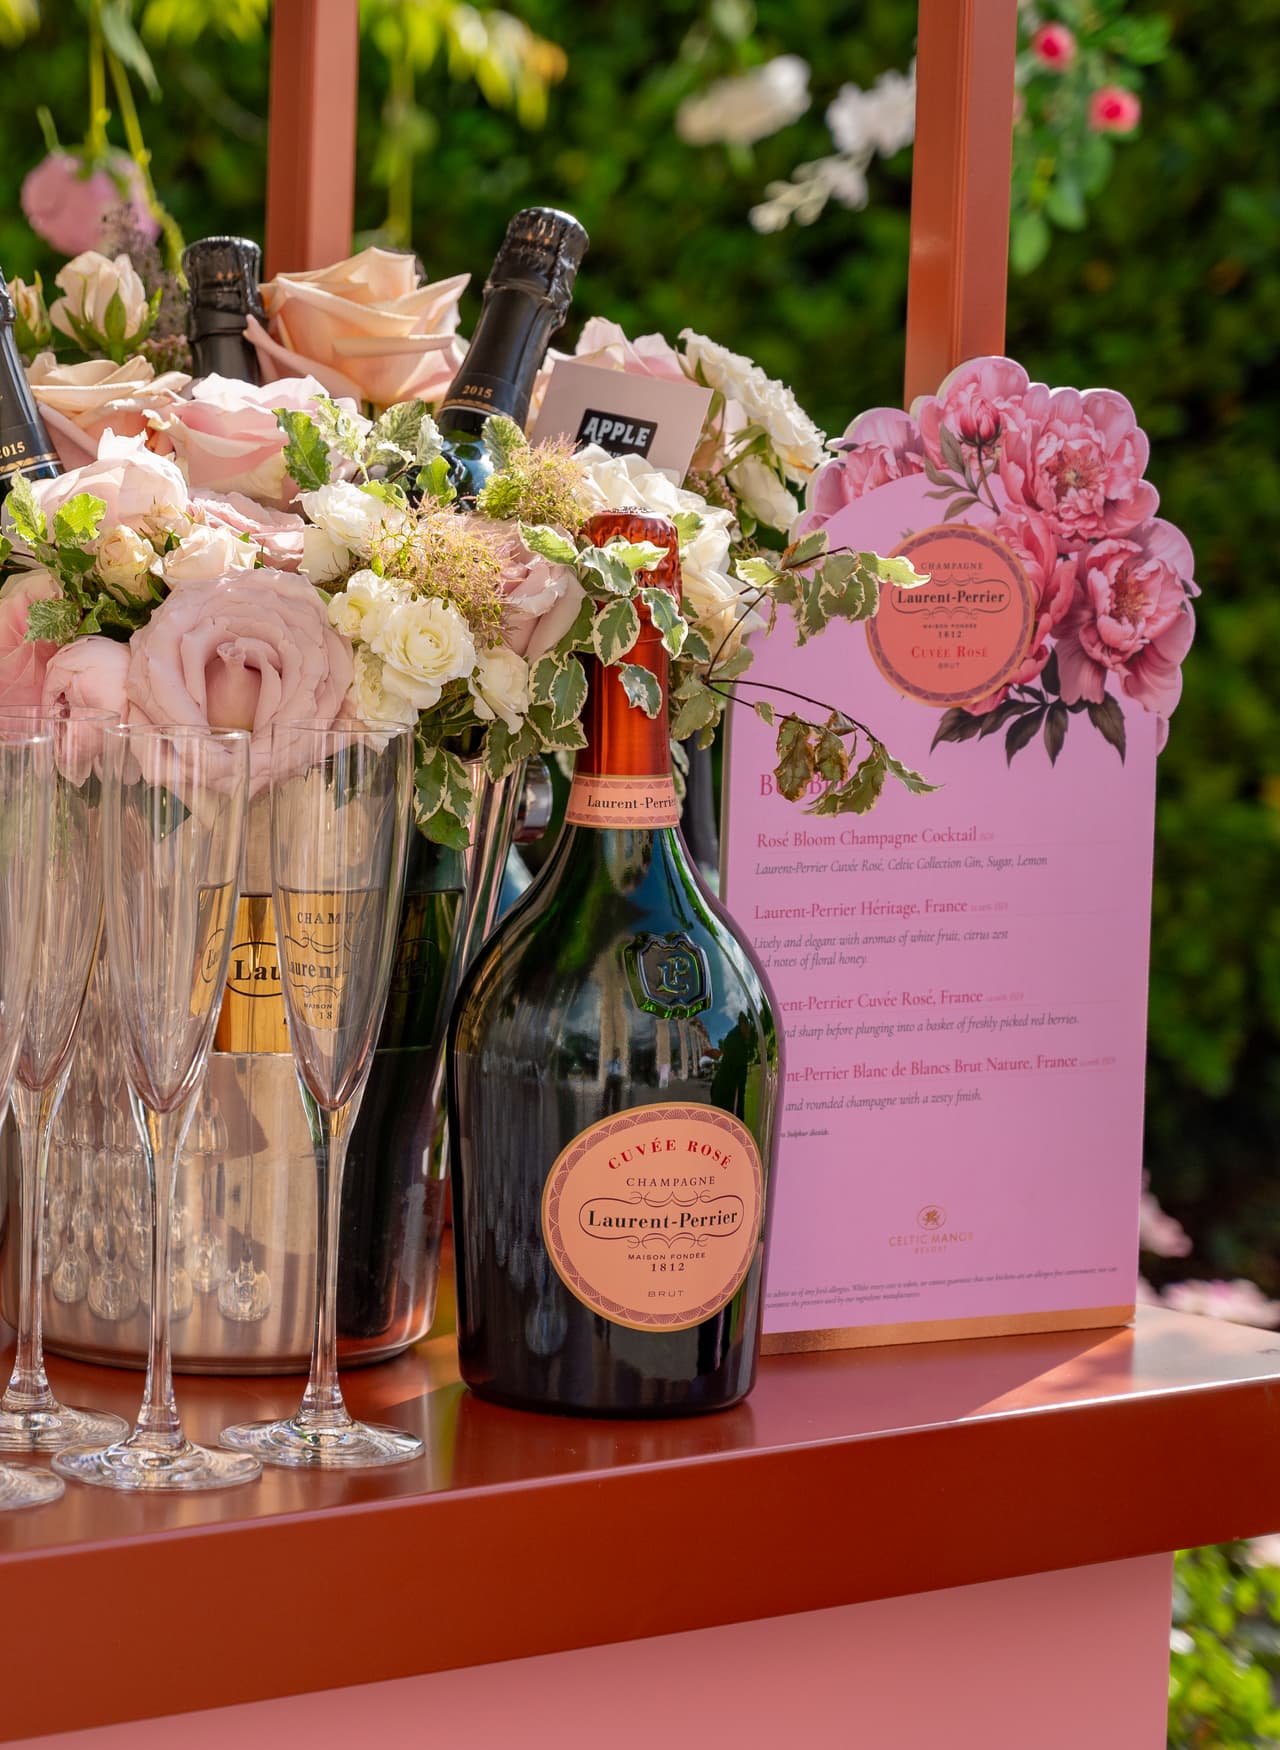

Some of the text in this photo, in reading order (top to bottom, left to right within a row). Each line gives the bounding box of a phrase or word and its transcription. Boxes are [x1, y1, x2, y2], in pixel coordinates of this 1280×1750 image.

[462, 384, 494, 399] 2015
[583, 417, 650, 447] APPLE
[920, 562, 983, 570] CHAMPAGNE
[897, 590, 1004, 604] Laurent-Perrier
[757, 831, 789, 848] Rosé
[794, 830, 836, 847] Bloom
[840, 829, 918, 849] Champagne
[922, 825, 977, 843] Cocktail
[755, 861, 828, 876] Laurent-Perrier
[917, 855, 962, 870] Collection
[1017, 854, 1048, 867] Lemon
[754, 903, 856, 919] Laurent-Perrier
[925, 898, 968, 914] France
[783, 934, 802, 948] and
[804, 933, 837, 951] elegant
[839, 931, 860, 946] with
[862, 934, 896, 946] aromas
[773, 956, 797, 968] notes
[779, 994, 853, 1011] rent-Perrier
[858, 990, 897, 1008] Cuvée
[940, 990, 983, 1005] France
[784, 1024, 796, 1038] nd
[798, 1024, 823, 1041] sharp
[826, 1022, 853, 1040] before
[855, 1021, 894, 1039] plunging
[896, 1020, 916, 1033] into
[917, 1022, 924, 1031] a
[926, 1017, 954, 1031] basket
[956, 1015, 969, 1033] of
[967, 1015, 998, 1033] freshly
[1000, 1013, 1028, 1031] picked
[1031, 1013, 1046, 1026] red
[786, 1065, 850, 1082] nt-Perrier
[853, 1062, 888, 1079] Blanc
[891, 1060, 906, 1077] de
[911, 1059, 951, 1076] Blancs
[955, 1058, 983, 1073] Brut
[986, 1056, 1033, 1071] Nature,
[1037, 1054, 1078, 1068] France
[785, 1098, 803, 1112] and
[806, 1096, 844, 1110] rounded
[846, 1094, 897, 1111] champagne
[900, 1091, 920, 1105] with
[922, 1095, 928, 1104] a
[608, 1137, 732, 1170] CUVÉE ROSÉ
[626, 1176, 716, 1187] CHAMPAGNE
[588, 1209, 738, 1229] Laurent-Perrier
[889, 1234, 928, 1247] CELTIC
[628, 1252, 706, 1261] MAISON FONDÉE
[651, 1262, 685, 1272] 1812
[648, 1290, 685, 1298] BRUT
